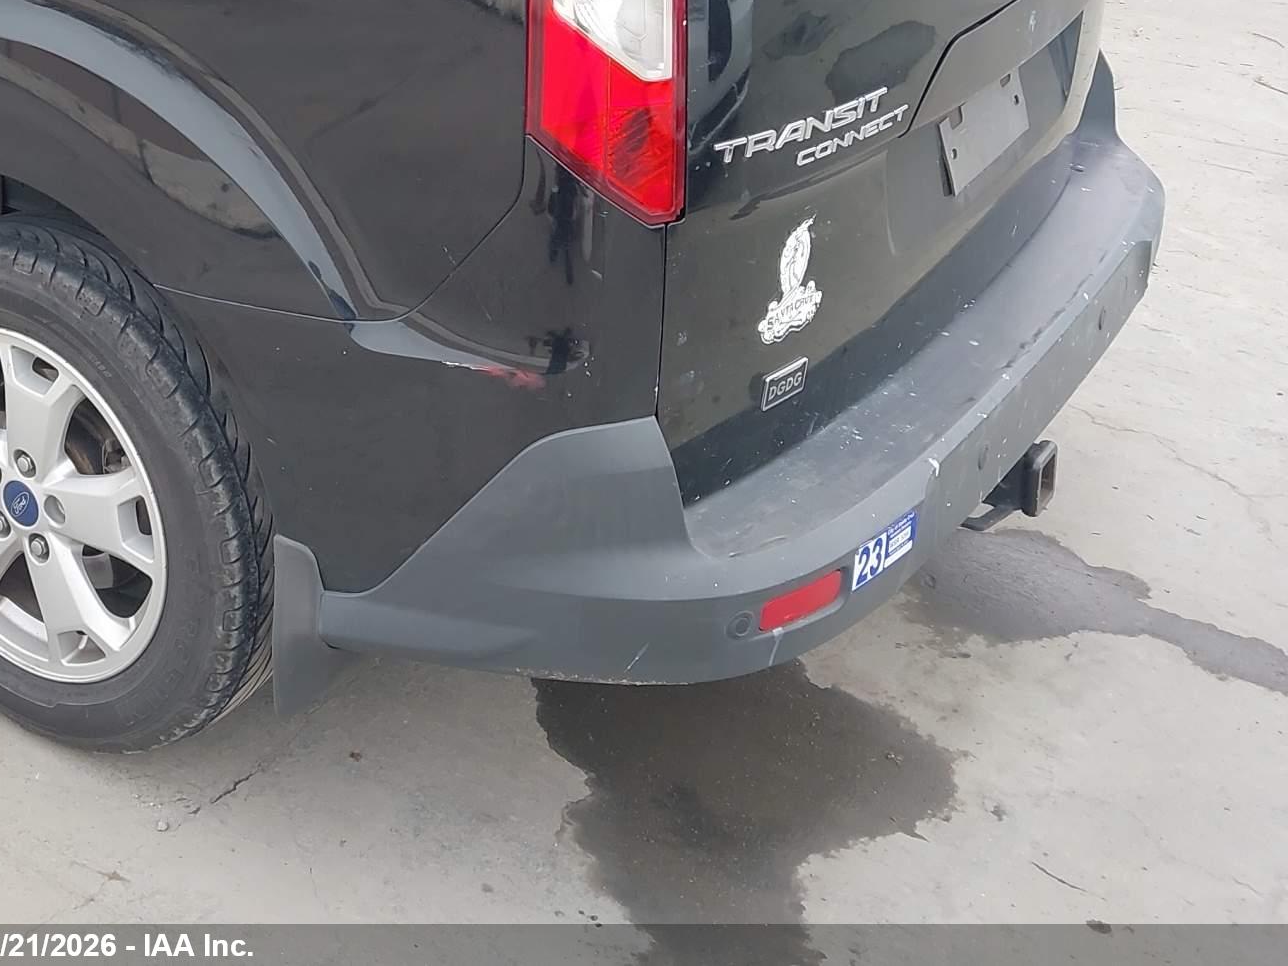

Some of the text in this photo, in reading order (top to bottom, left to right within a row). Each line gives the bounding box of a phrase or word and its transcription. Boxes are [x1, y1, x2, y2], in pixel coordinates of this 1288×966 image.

[713, 86, 888, 164] TRANSIT
[795, 104, 909, 167] CONNECT
[767, 371, 803, 402] DGDG
[855, 536, 883, 586] 23
